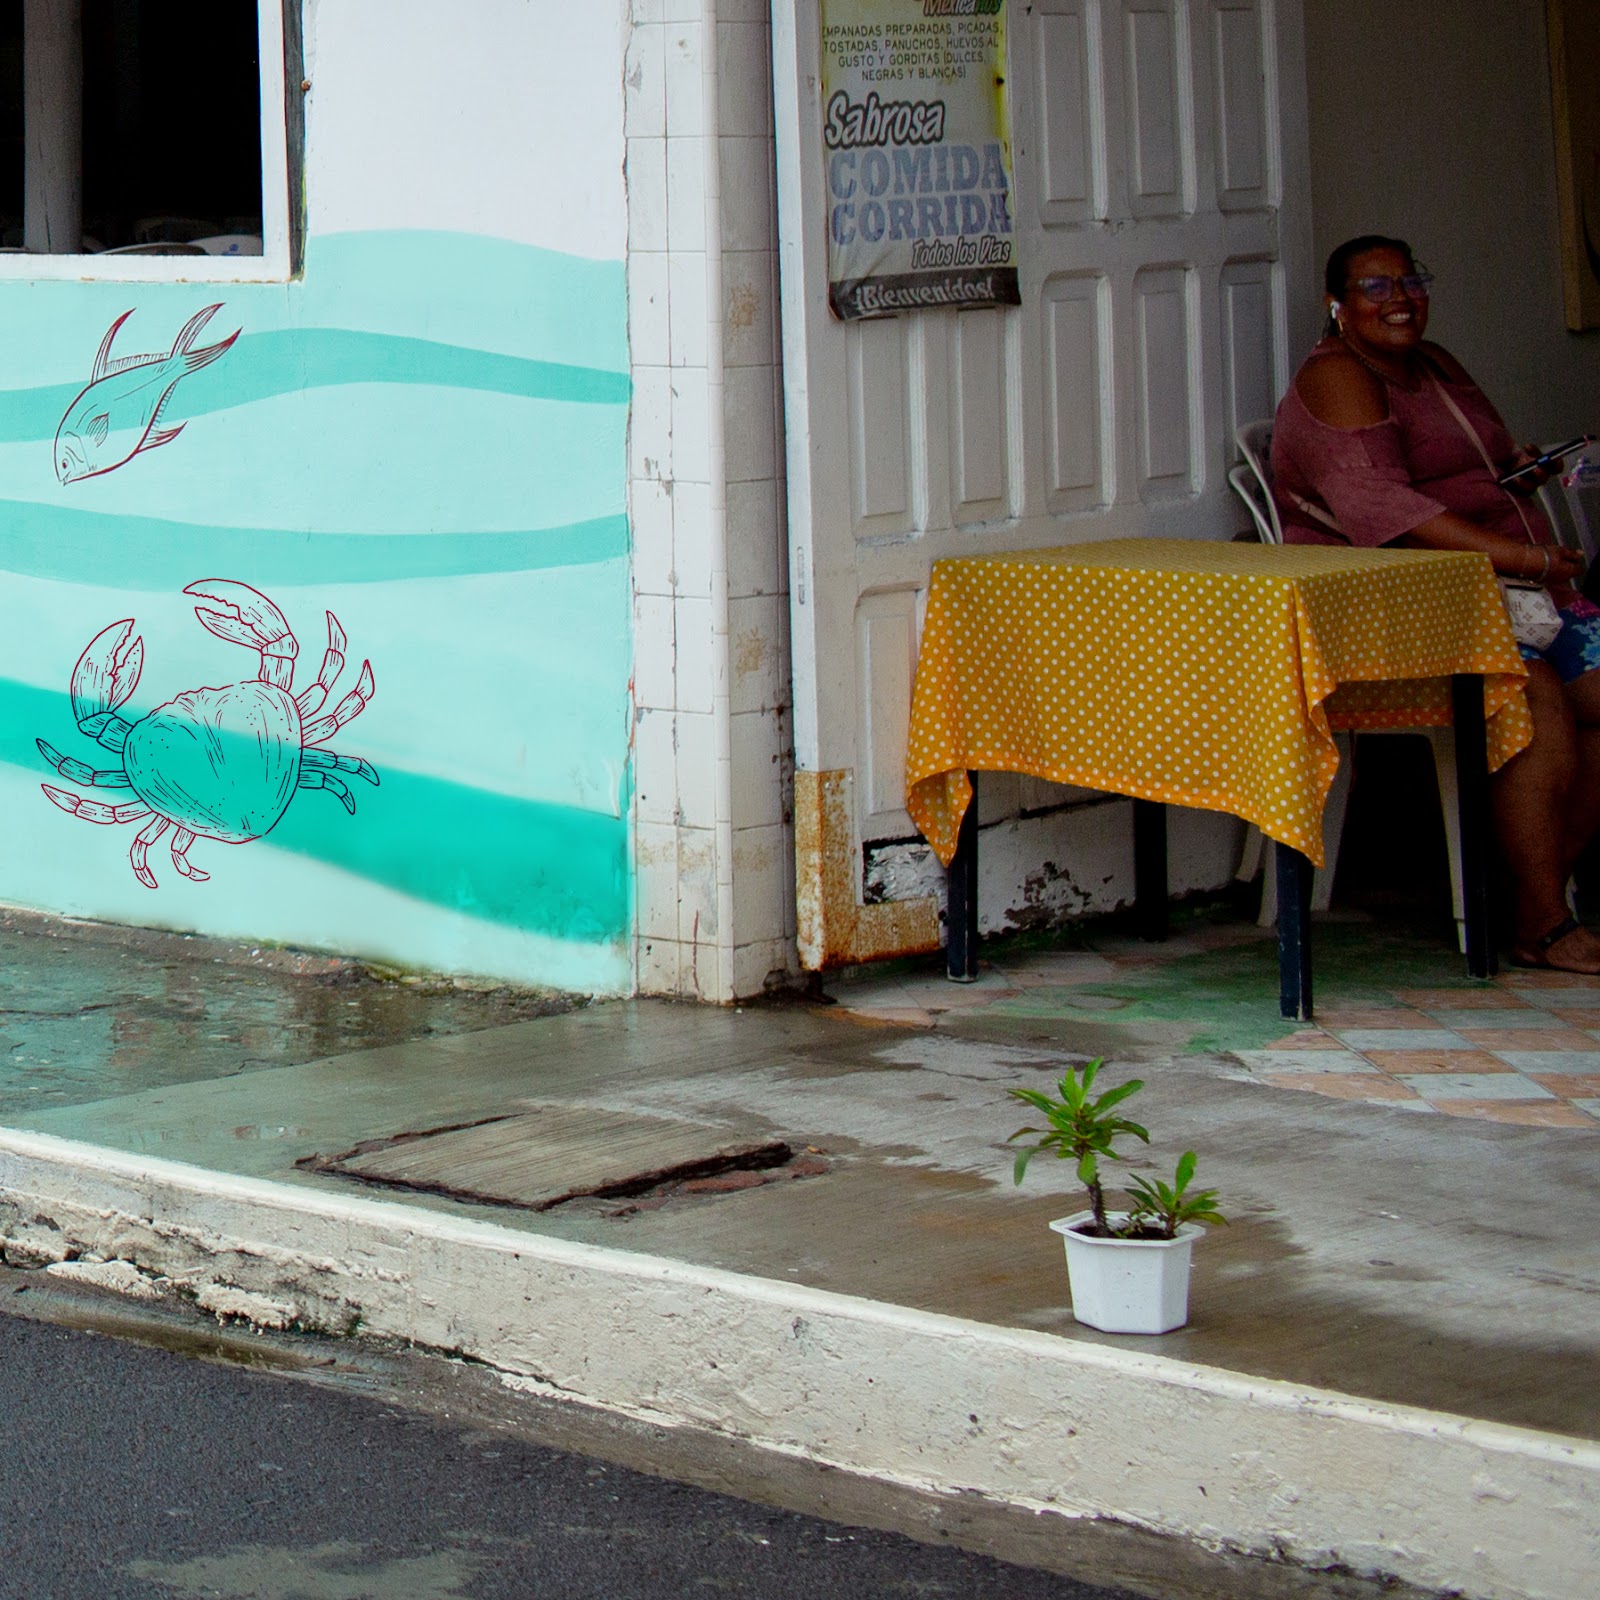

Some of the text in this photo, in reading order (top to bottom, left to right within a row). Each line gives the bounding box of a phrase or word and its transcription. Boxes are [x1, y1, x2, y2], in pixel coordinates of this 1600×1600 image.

[886, 23, 955, 36] PREPARADAS,
[958, 21, 1003, 35] PICADAS,
[824, 36, 1000, 53] TOSTADAS, PANUCHOS, HUEVOS AL
[838, 55, 874, 67] GUSTO
[878, 55, 885, 66] Y
[889, 53, 940, 65] GORDITAS
[862, 69, 904, 81] NEGRAS
[908, 68, 915, 79] Y
[825, 90, 946, 149] Sabrosa
[830, 144, 1008, 199] COMIDA
[831, 193, 1012, 246] CORRIDA
[912, 238, 953, 269] Todos
[954, 236, 976, 265] los
